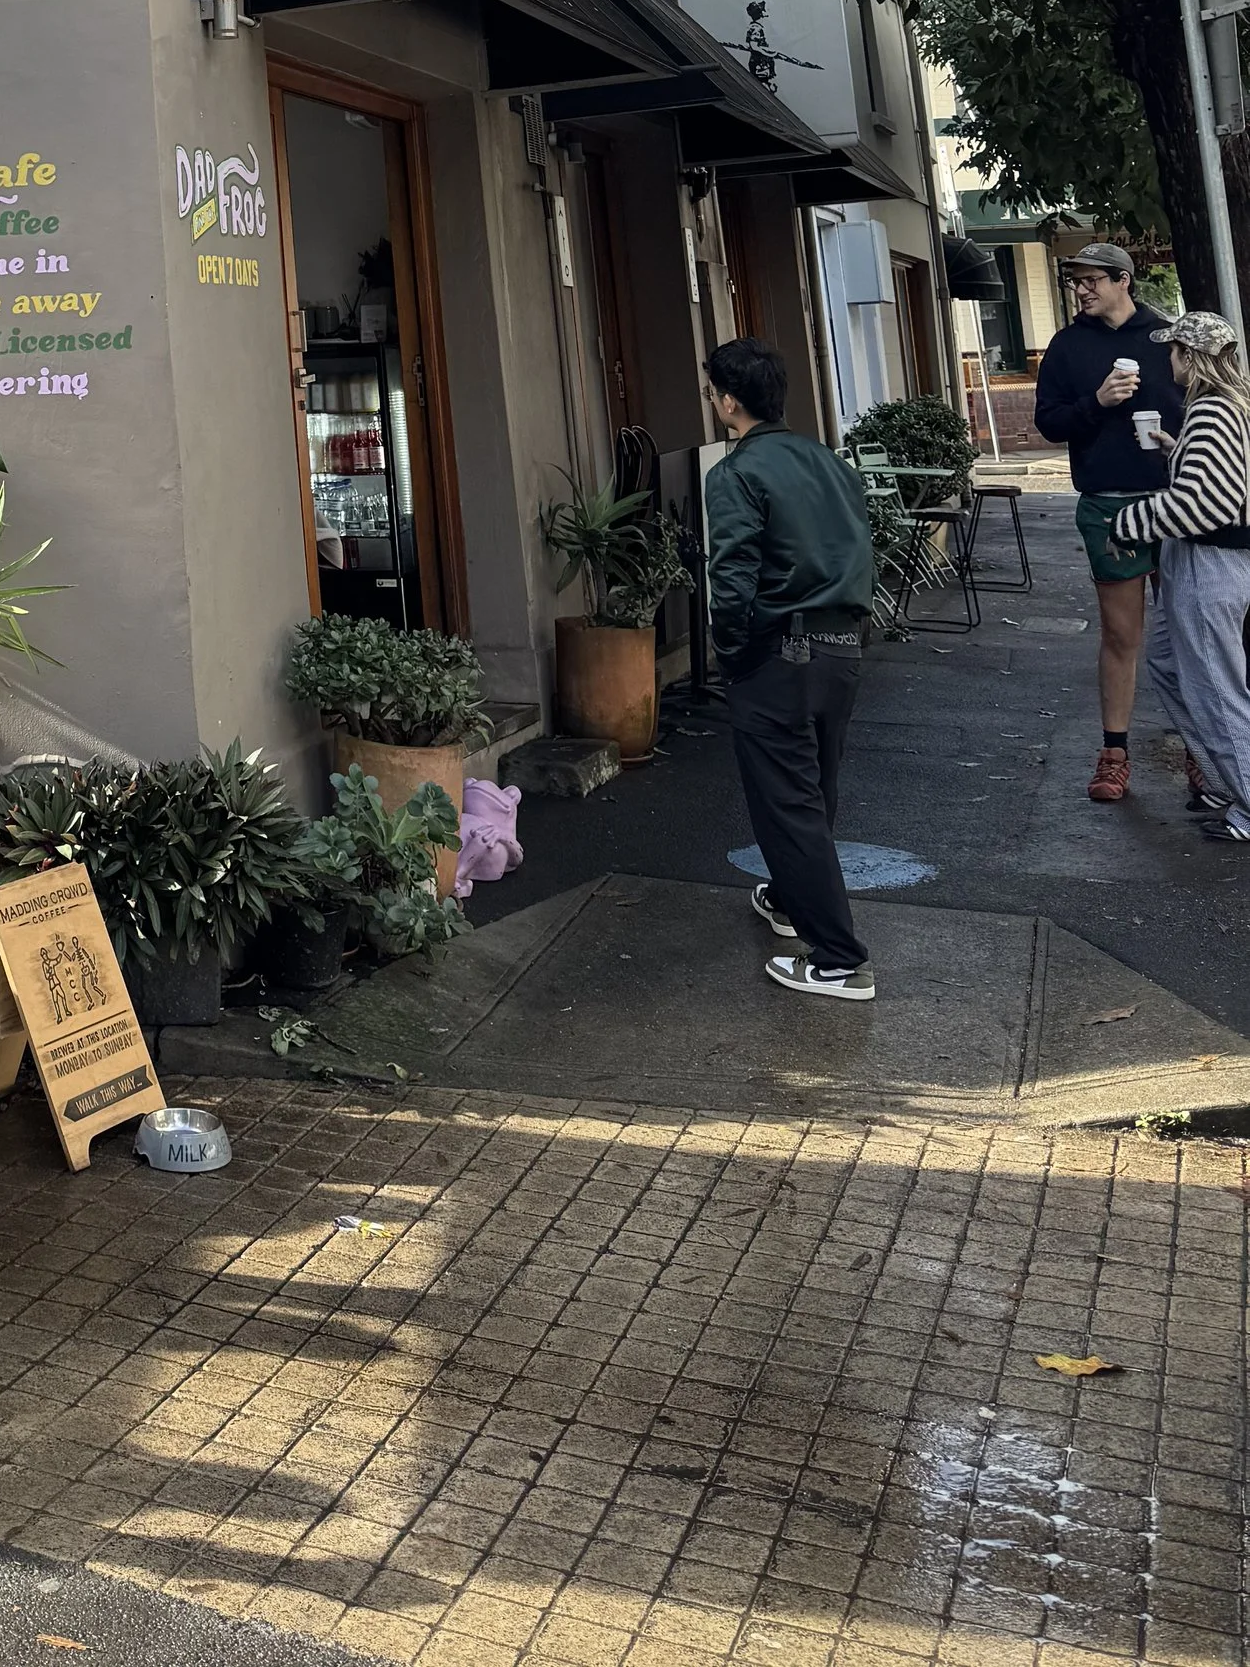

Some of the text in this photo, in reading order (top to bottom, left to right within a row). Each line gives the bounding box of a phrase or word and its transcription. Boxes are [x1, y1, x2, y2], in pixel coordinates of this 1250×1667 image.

[175, 145, 216, 218] DAD
[216, 142, 267, 236] FROG
[35, 248, 70, 274] in
[198, 254, 259, 287] OPEN 7 DAYS
[12, 292, 102, 318] away
[0, 882, 88, 924] MADDING CROWD
[32, 906, 66, 924] COFFEE
[50, 1019, 129, 1061] BREWED AT THIS LOCATION
[54, 1032, 134, 1079] MONDAY TO SUNDAY
[75, 1093, 99, 1115] WALK
[100, 1085, 117, 1103] THIS
[168, 1142, 207, 1163] MILK
